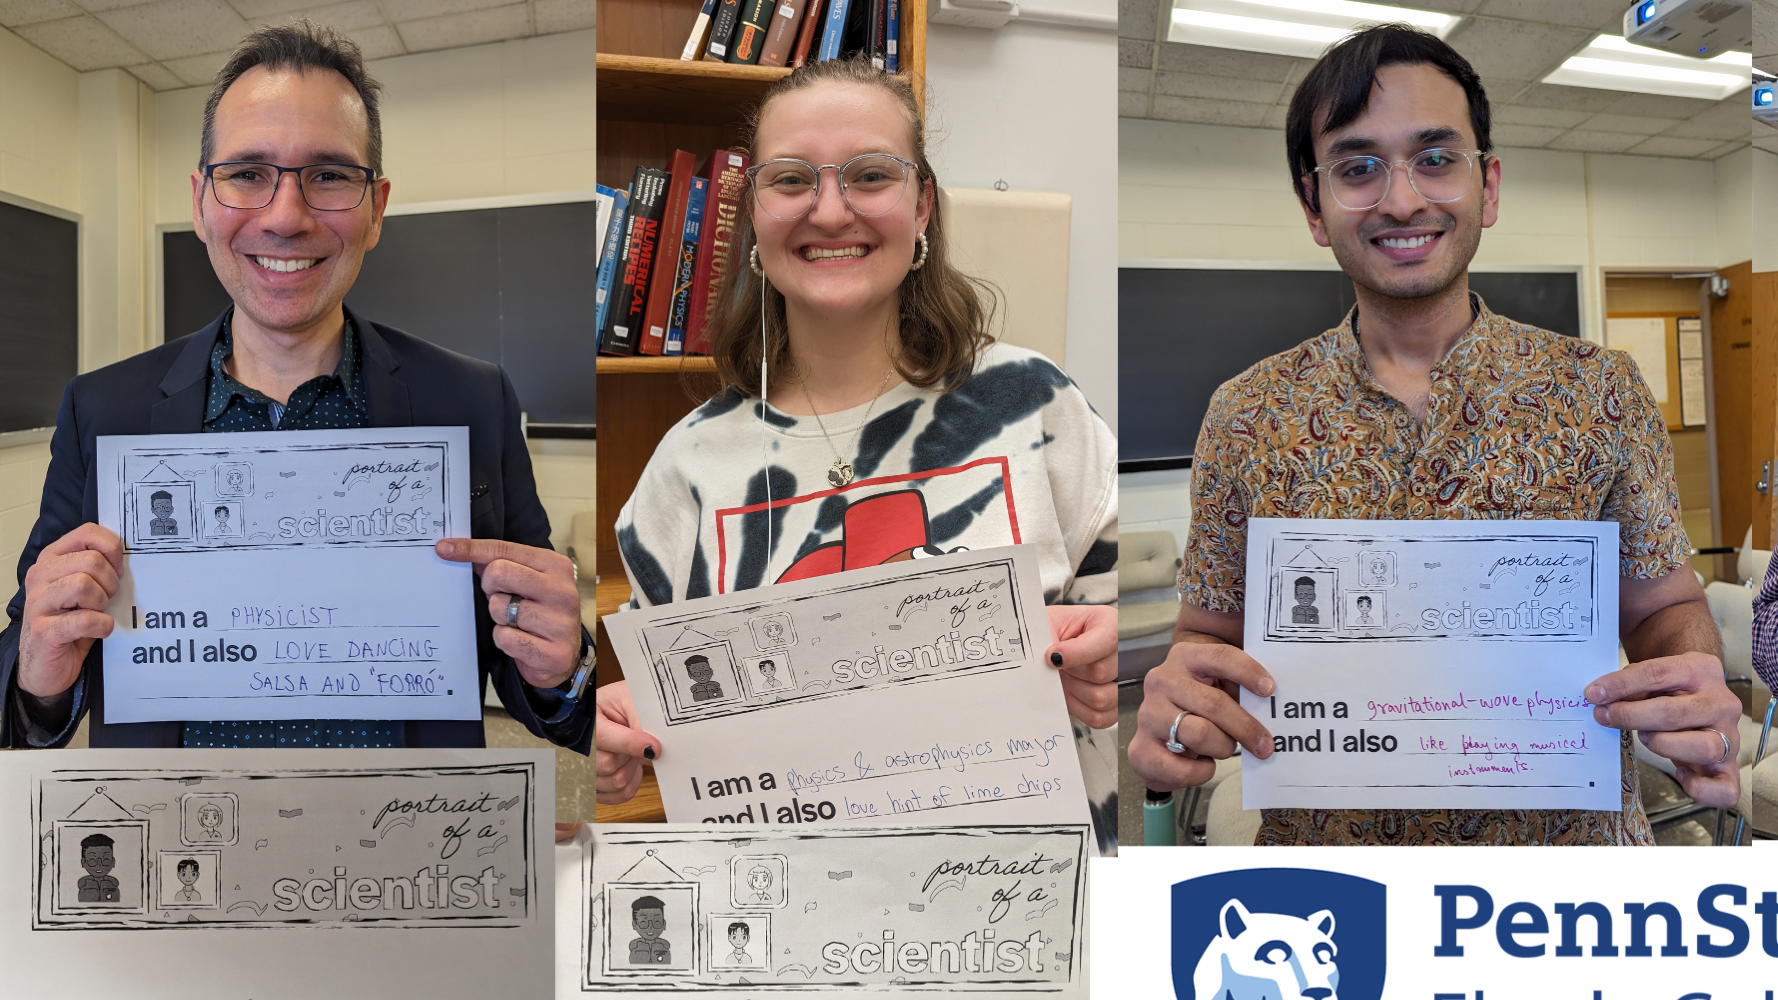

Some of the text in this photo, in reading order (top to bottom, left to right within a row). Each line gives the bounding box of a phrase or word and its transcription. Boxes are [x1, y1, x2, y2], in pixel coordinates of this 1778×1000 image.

[623, 215, 647, 285] RECIPES
[629, 218, 659, 316] NUMERICAL
[681, 244, 694, 291] MODERN
[674, 290, 688, 327] PHYSICS
[132, 606, 138, 629] I
[145, 609, 186, 629] am
[193, 609, 208, 629] a
[132, 640, 181, 665] and
[188, 639, 195, 663] I
[202, 638, 258, 663] also
[275, 640, 332, 660] LOVE
[322, 674, 361, 694] AND
[1527, 690, 1590, 717] physicis
[1420, 736, 1449, 751] like
[1529, 732, 1589, 750] musical
[786, 764, 846, 796] physics
[884, 738, 994, 773] astrophysics
[1006, 734, 1065, 769] major
[844, 775, 1062, 818] love hint of lime chips
